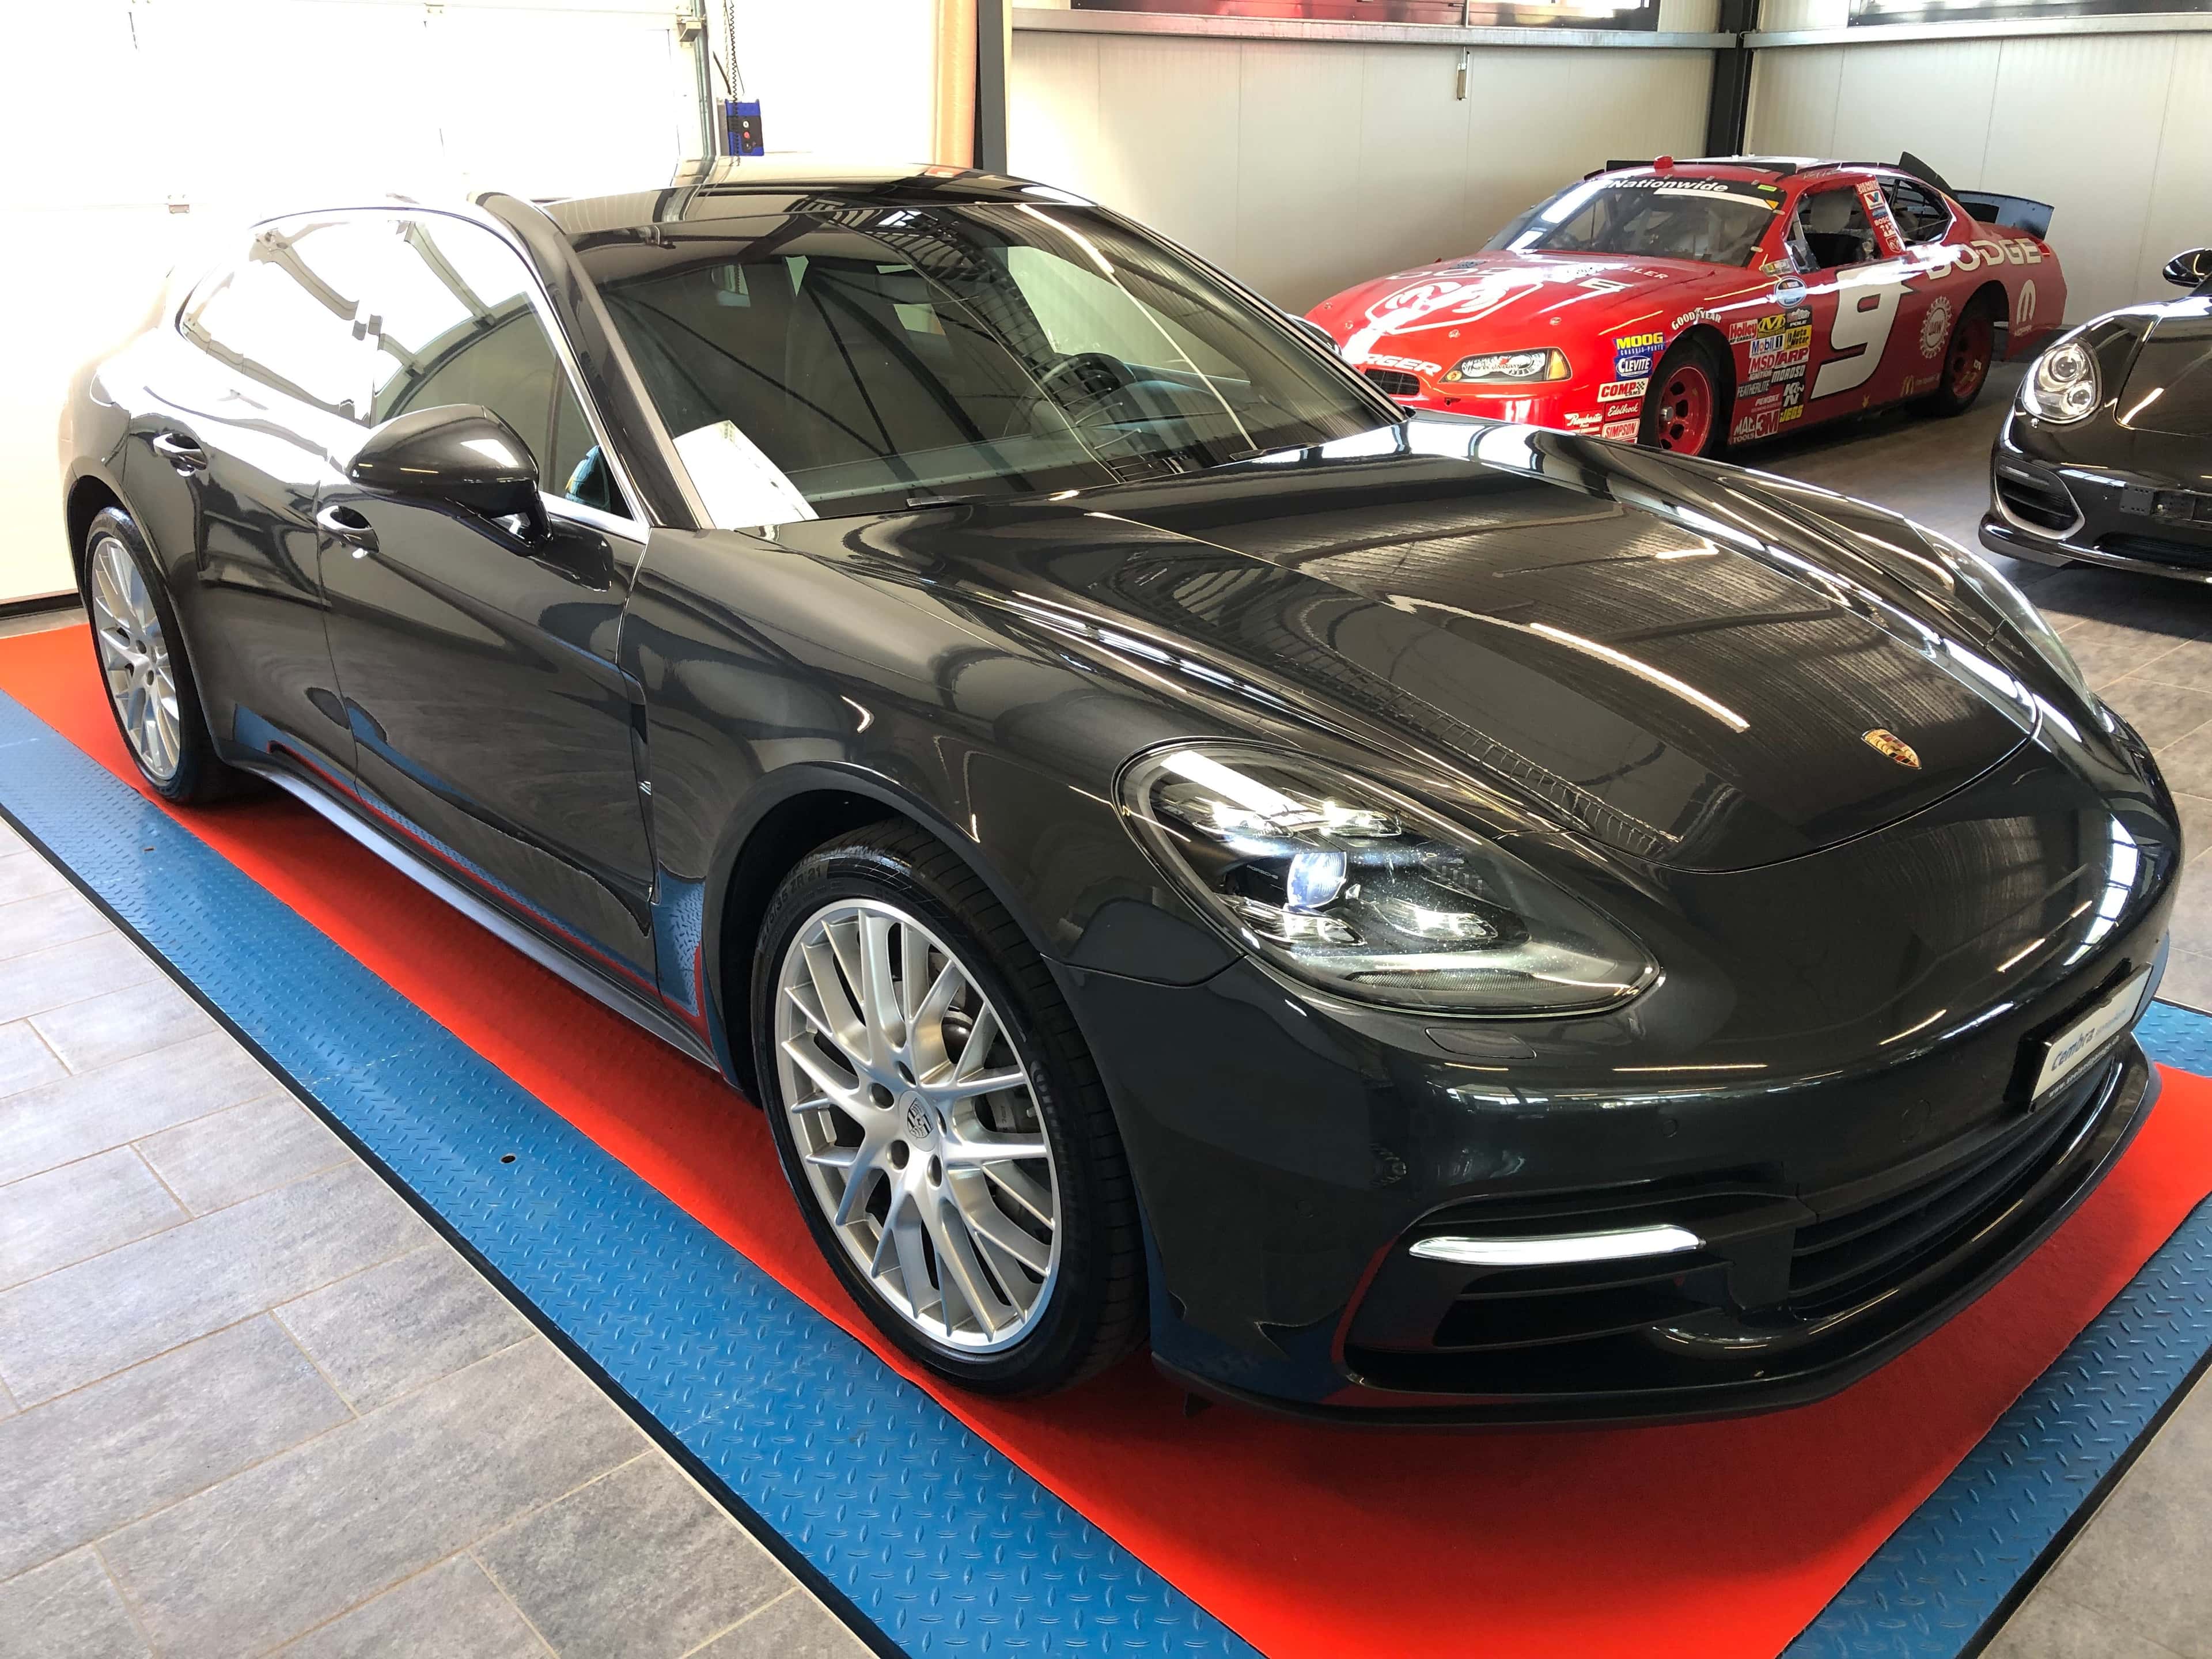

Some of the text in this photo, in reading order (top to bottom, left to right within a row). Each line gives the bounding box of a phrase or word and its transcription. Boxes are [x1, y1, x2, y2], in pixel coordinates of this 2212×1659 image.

[1610, 179, 1729, 192] Nationwide
[1874, 216, 1892, 226] BOSC
[1671, 306, 1722, 330] GOODYEAR
[1730, 321, 1757, 338] Holley
[1810, 261, 1907, 399] 9
[1616, 332, 1664, 350] MOOG
[1752, 338, 1775, 354] Mobil
[1618, 357, 1650, 373] CLEVITE
[1750, 354, 1774, 373] MSD
[1775, 347, 1809, 366] ARP
[1601, 381, 1637, 398] COMP
[1737, 380, 1770, 397] FEATHERLITE
[1608, 403, 1639, 417] Edelbrock
[1605, 422, 1635, 439] SIMPSON
[1733, 416, 1755, 435] MAC
[808, 865, 821, 881] 21
